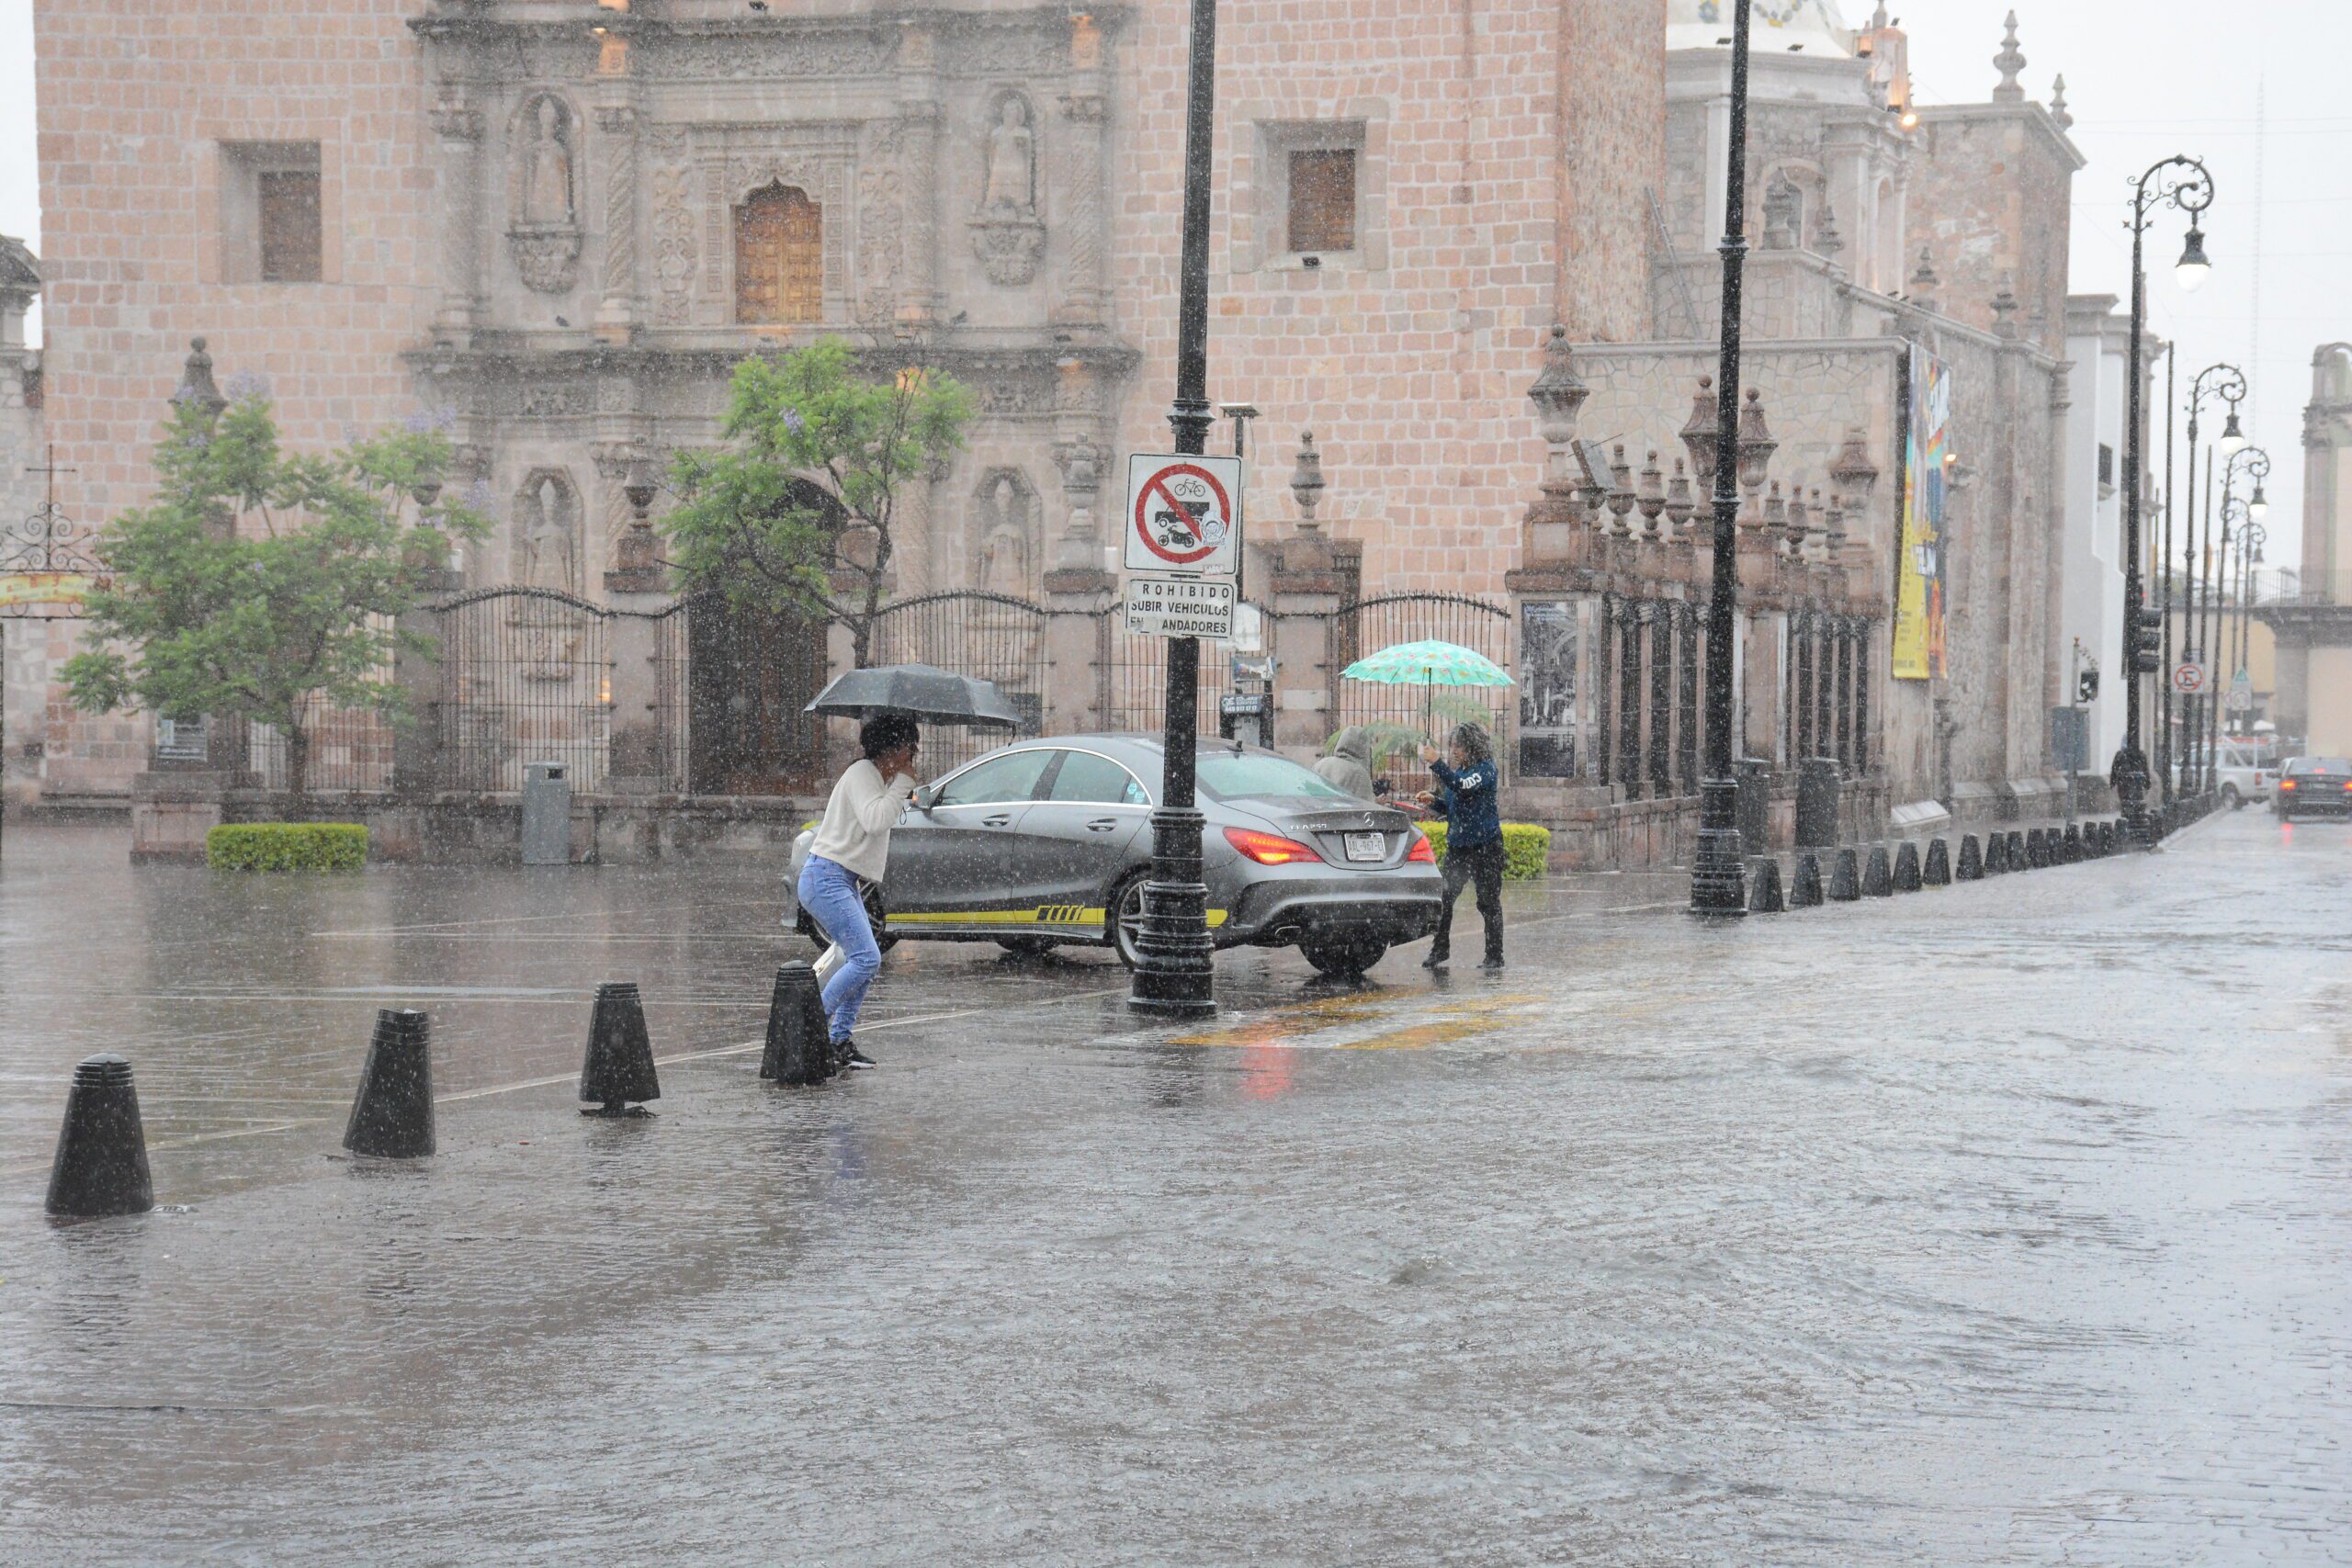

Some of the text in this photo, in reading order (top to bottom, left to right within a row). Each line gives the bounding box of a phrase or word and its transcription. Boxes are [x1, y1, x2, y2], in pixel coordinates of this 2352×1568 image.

[1142, 583, 1229, 598] ROHIBIDO
[1131, 601, 1229, 616] SUBIR VEHICULOS
[1161, 619, 1227, 633] ANDADORES
